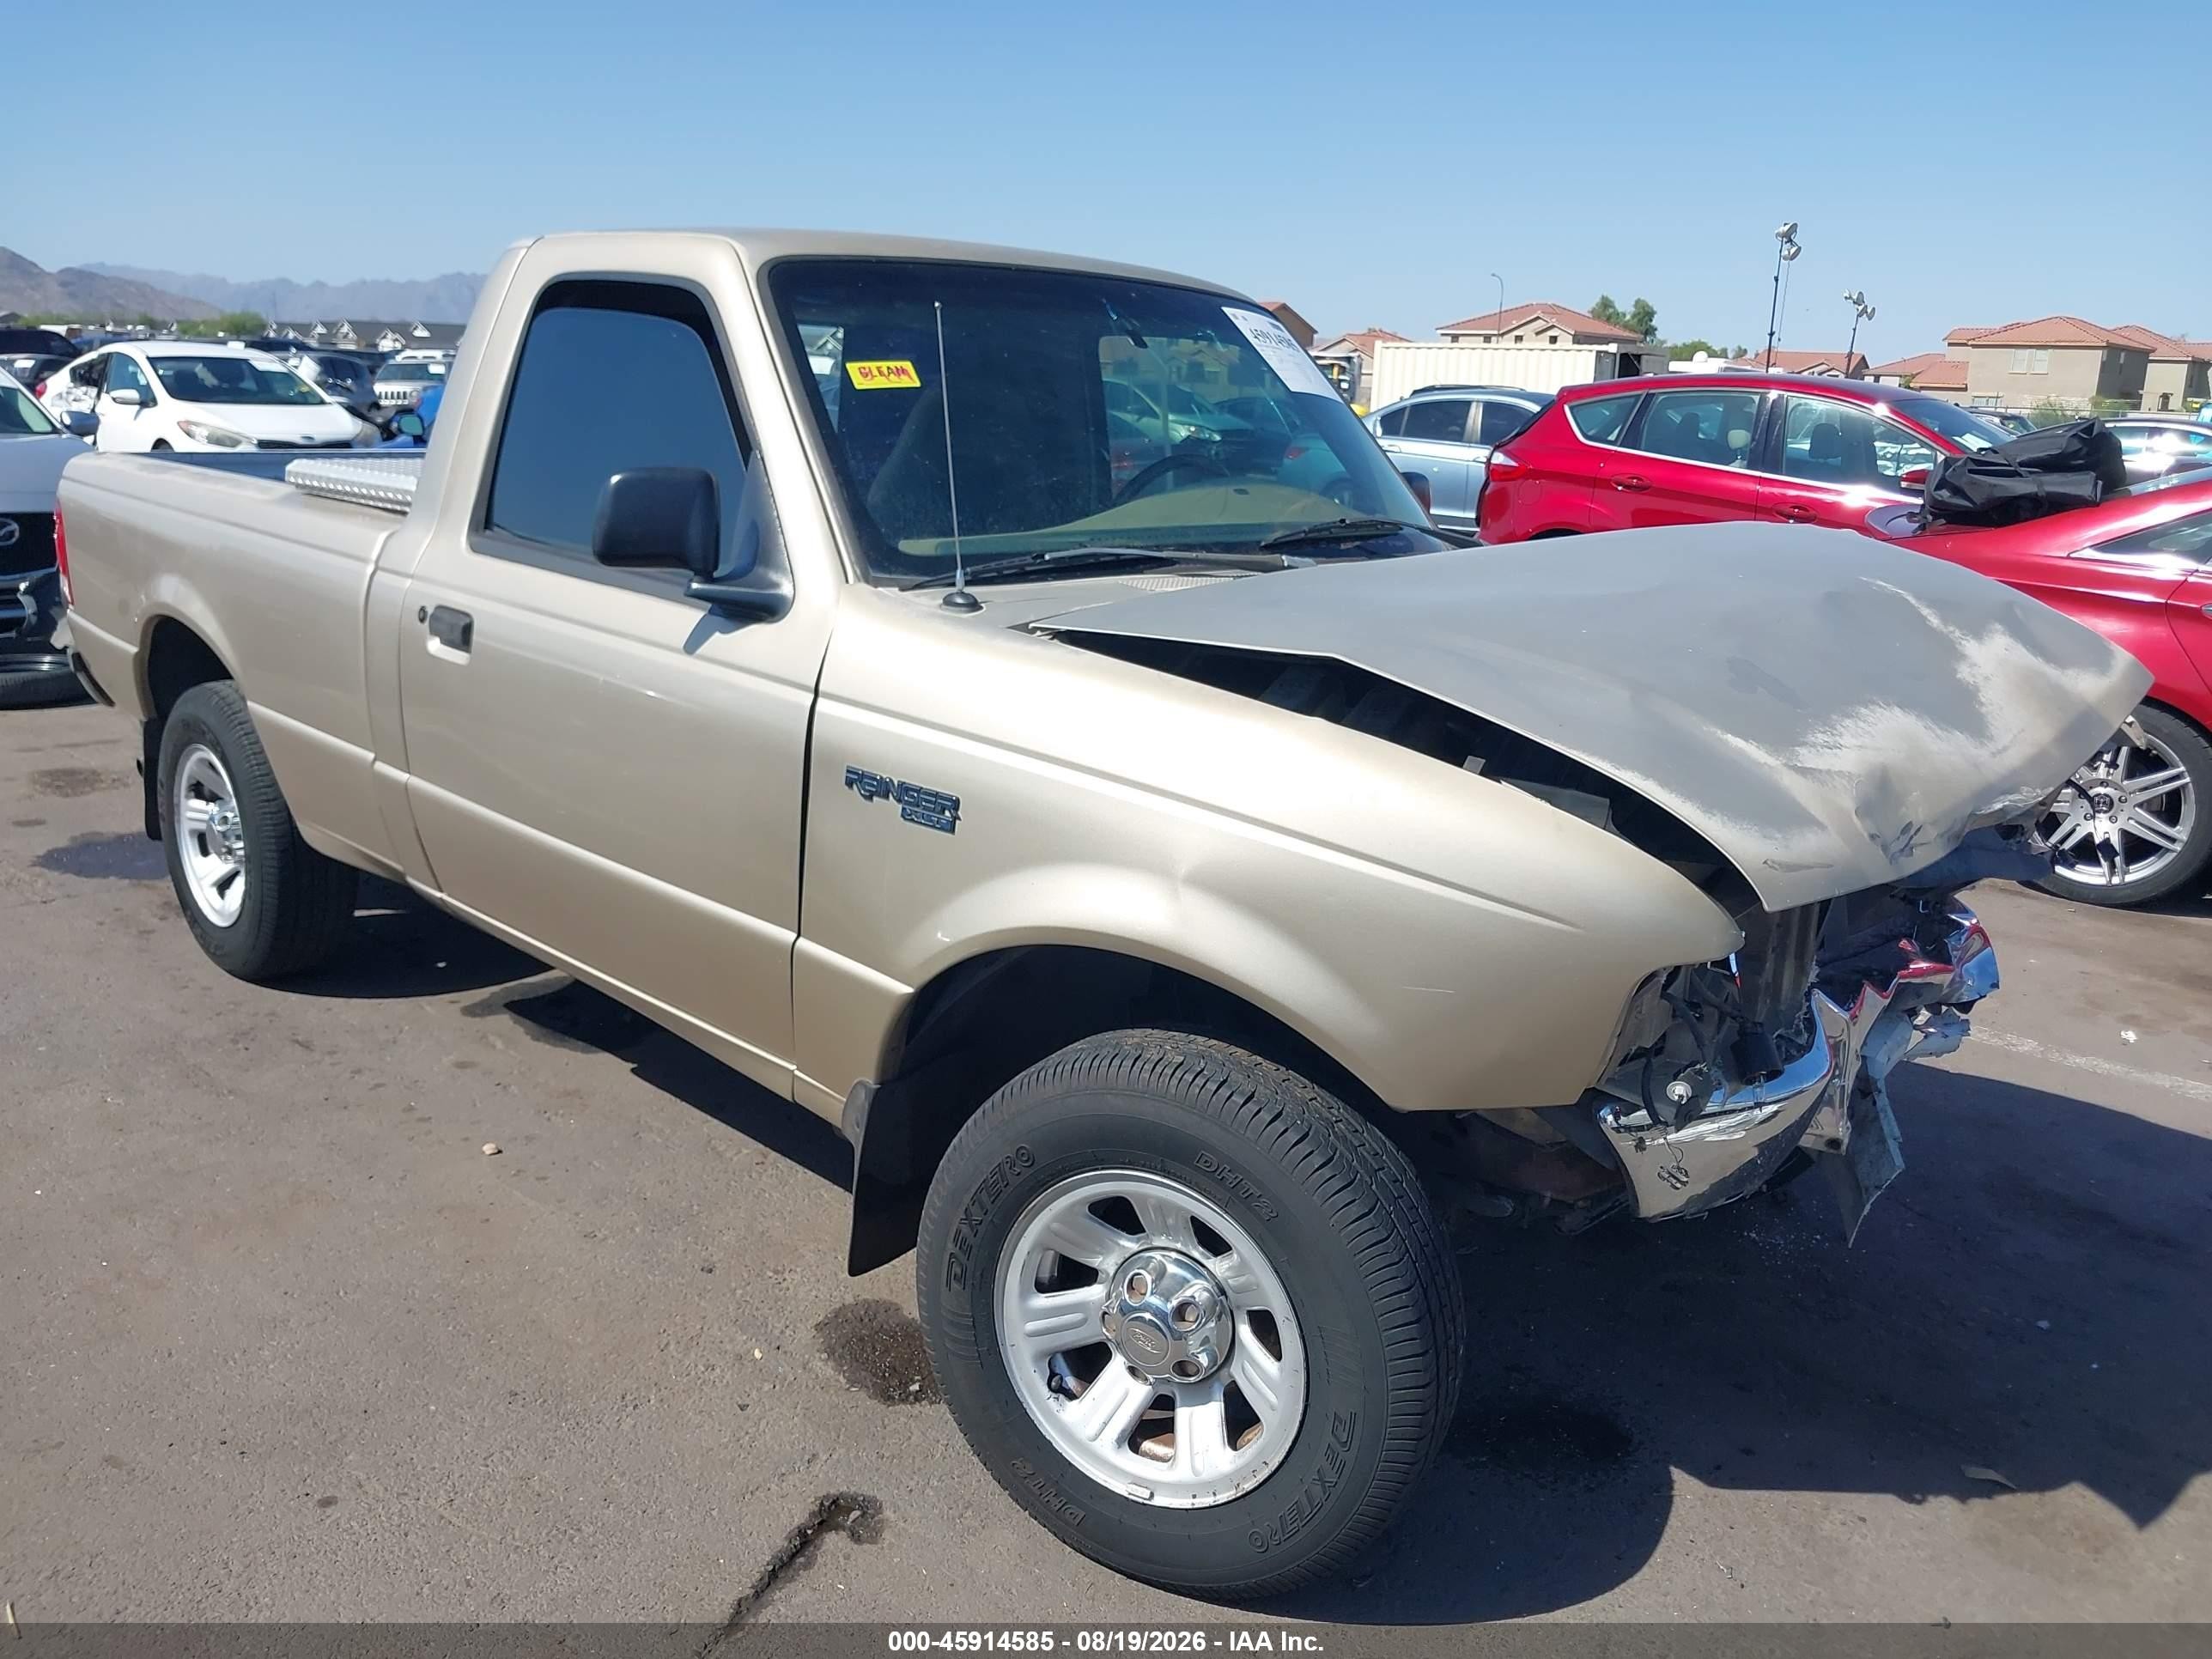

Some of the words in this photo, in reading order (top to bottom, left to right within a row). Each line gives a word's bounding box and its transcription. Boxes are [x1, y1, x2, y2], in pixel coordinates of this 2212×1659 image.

[844, 764, 963, 822] RANGER
[945, 1143, 1036, 1291] DEXTERO
[1194, 1150, 1279, 1222] DHT2
[1011, 1456, 1086, 1527] DHT2
[1248, 1411, 1358, 1553] DEXTERO
